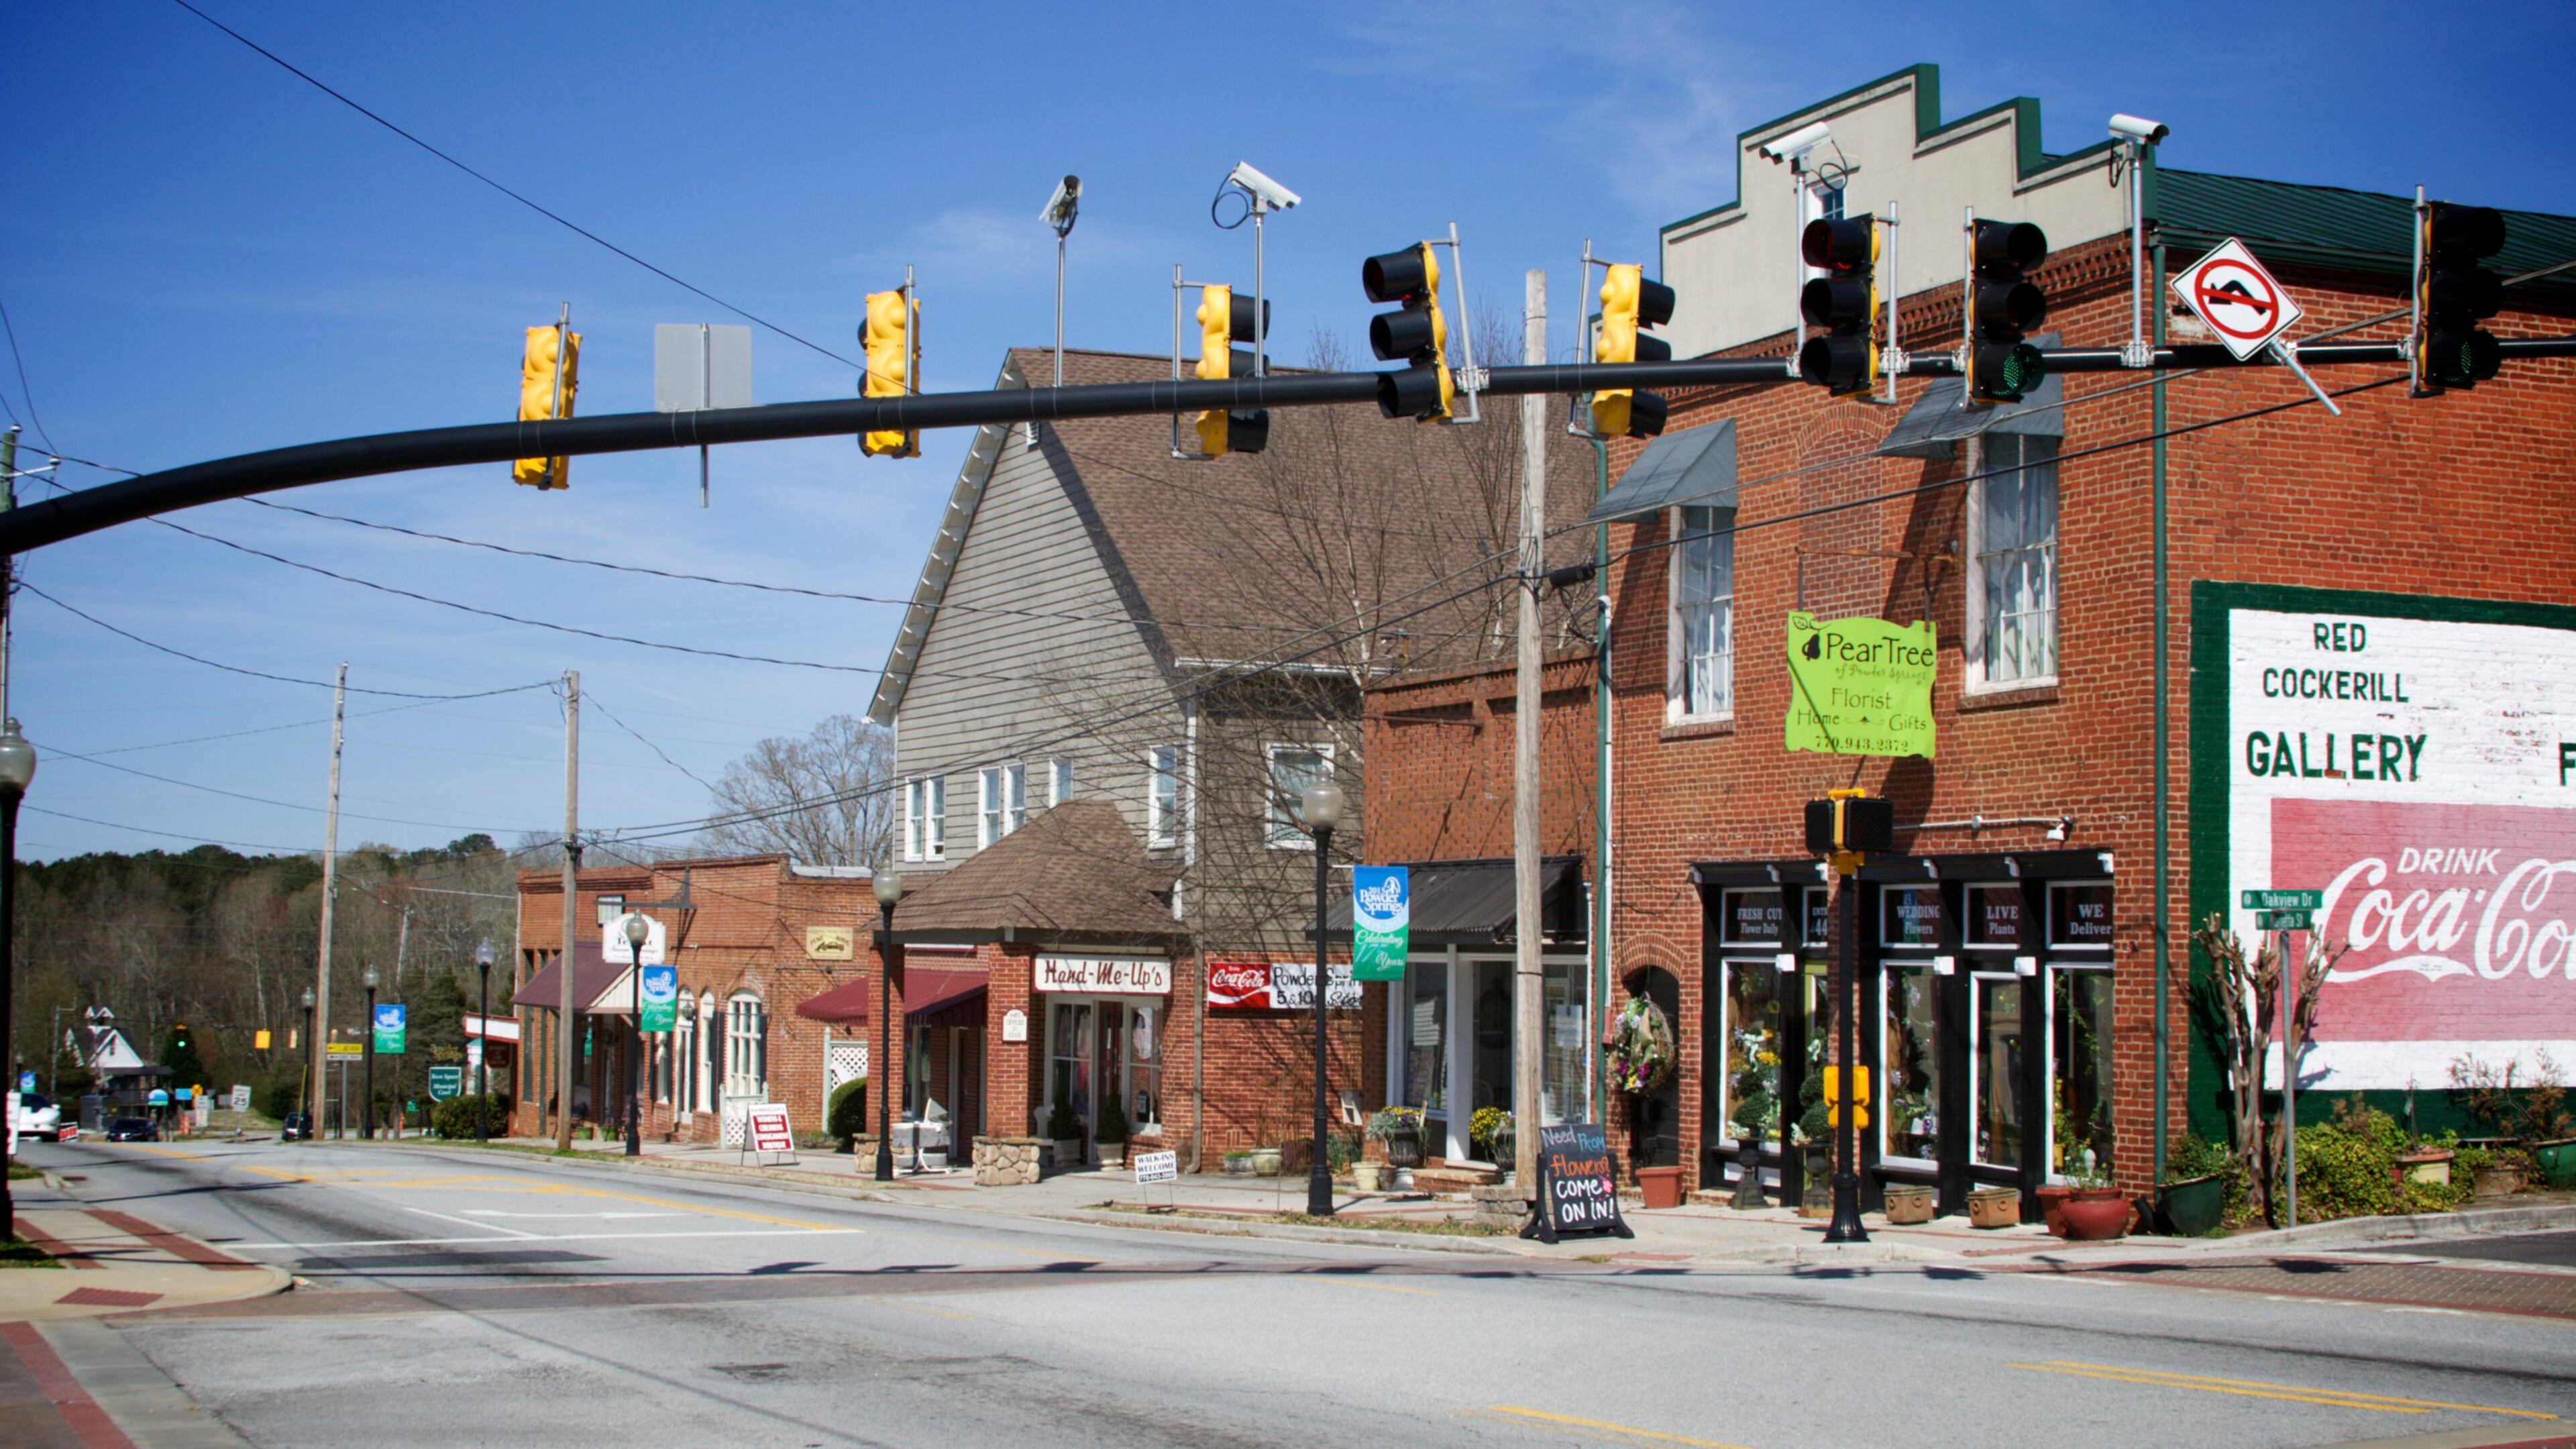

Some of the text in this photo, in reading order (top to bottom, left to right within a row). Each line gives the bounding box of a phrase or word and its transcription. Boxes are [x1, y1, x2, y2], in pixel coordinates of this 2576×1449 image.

[2314, 623, 2366, 652] RED
[1835, 663, 1927, 685] of Powder Springs
[2263, 667, 2410, 702] COCKERILL
[1831, 687, 1892, 709] Florist
[1796, 709, 1927, 731] Home Gifts
[1815, 736, 1909, 752] 770.943.2372
[2246, 731, 2427, 782] GALLERY
[2397, 847, 2501, 875] DRINK
[1360, 888, 1399, 903] Powder
[2261, 892, 2312, 906] Oakview Dr
[1364, 900, 1403, 915] Springs
[1737, 908, 1762, 920] FRESH
[1896, 906, 1940, 918] WEDDING
[1987, 906, 2018, 920] LIVE
[2078, 904, 2103, 918] WE
[2296, 913, 2304, 927] St
[1740, 922, 1778, 936] Flower Daily
[1905, 922, 1933, 934] Flowers
[1989, 922, 2016, 935] Plants
[2070, 922, 2112, 934] Deliver
[1355, 930, 1403, 949] Celebrating
[1376, 951, 1404, 971] Years
[1212, 969, 1266, 988] Coca-Cola
[1274, 967, 1316, 986] Powde
[1277, 991, 1287, 1005] 5
[1289, 994, 1296, 1004] &
[234, 1097, 247, 1106] 25
[1541, 1126, 1576, 1147] Need
[1138, 1154, 1174, 1163] WALK-INS
[1138, 1162, 1174, 1173] WELCOME
[1562, 1202, 1585, 1223] ON
